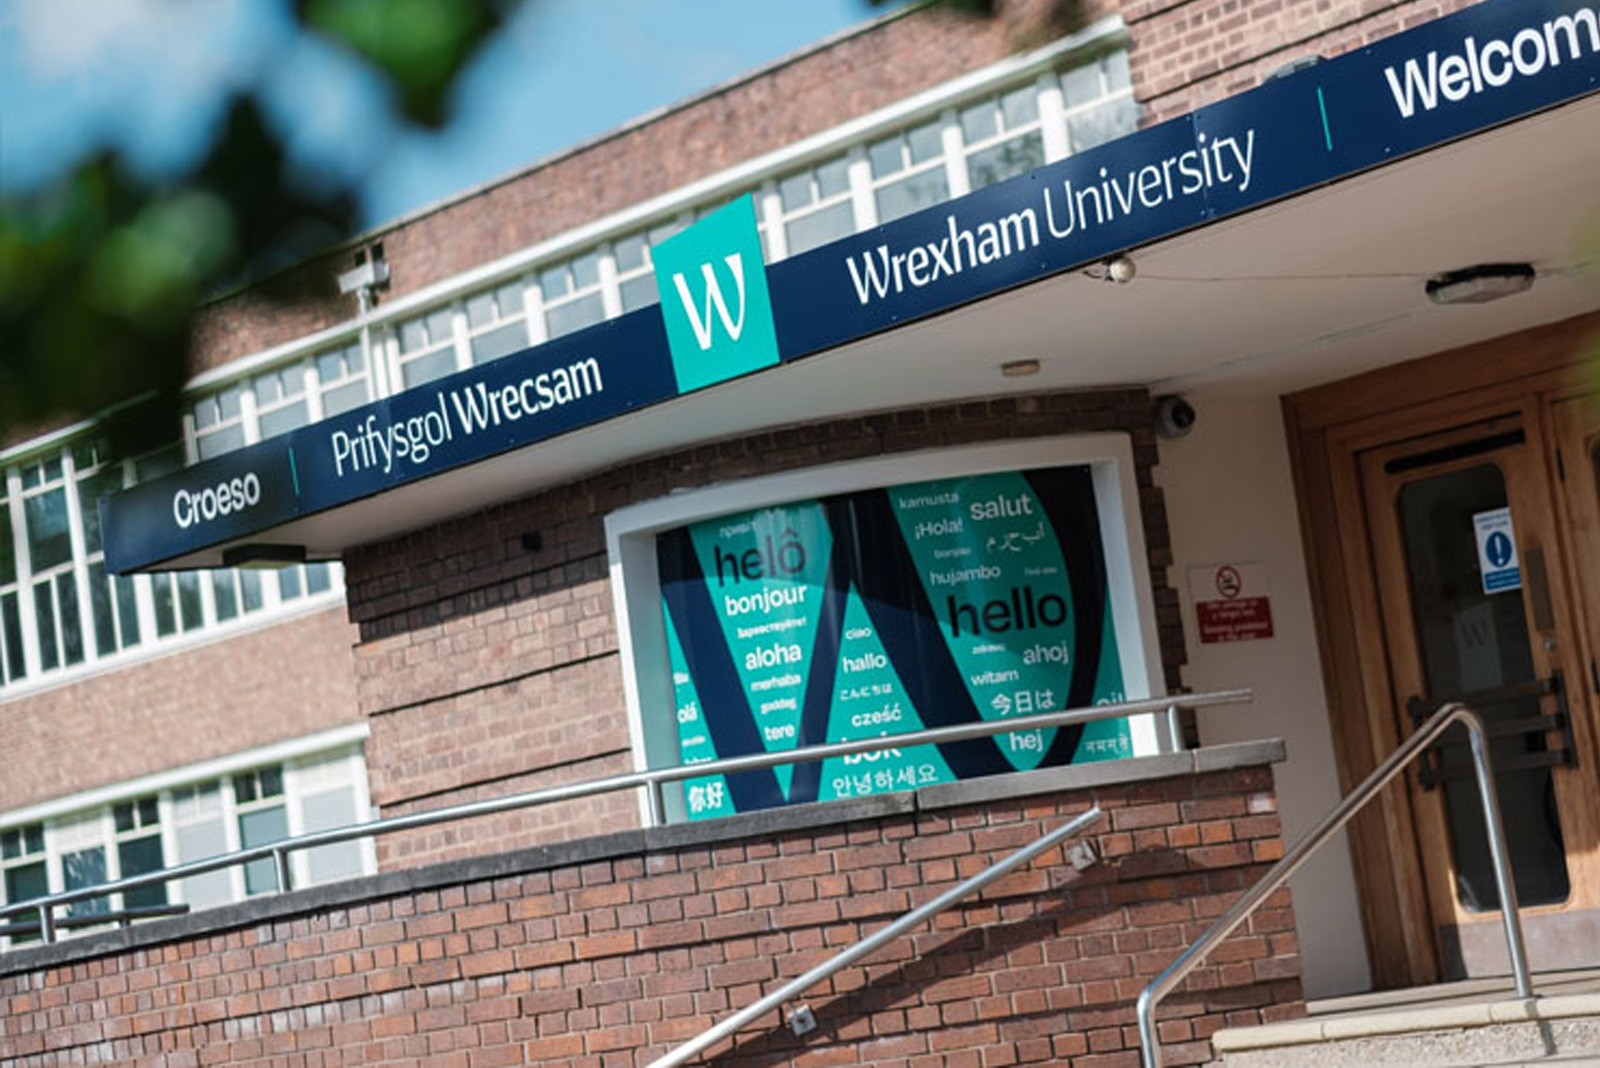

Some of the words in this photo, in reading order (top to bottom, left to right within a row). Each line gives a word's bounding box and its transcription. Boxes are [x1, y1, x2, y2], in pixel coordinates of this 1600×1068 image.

[1384, 7, 1600, 118] Welcom
[846, 206, 1040, 304] Wrexham
[1044, 129, 1255, 239] University
[673, 252, 746, 351] W
[331, 393, 452, 476] Prifysgol
[452, 357, 603, 433] Wrecsam
[173, 471, 260, 528] Croeso
[899, 491, 960, 510] kamusta
[970, 493, 1033, 521] salut
[914, 517, 964, 540] ¡Hola!
[714, 527, 806, 587] helô
[930, 564, 1001, 586] hujambo
[725, 585, 807, 616] bonjour
[946, 585, 1068, 638] hello
[846, 627, 871, 640] ciao
[745, 643, 802, 670] aloha
[842, 653, 887, 673] hallo
[1023, 641, 1069, 665] ahoj
[970, 668, 1019, 686] witam
[851, 703, 902, 727] cześć
[990, 688, 1054, 715] 今日は
[764, 724, 795, 741] tere
[1009, 728, 1043, 753] hej
[832, 764, 938, 798] 안녕하세요
